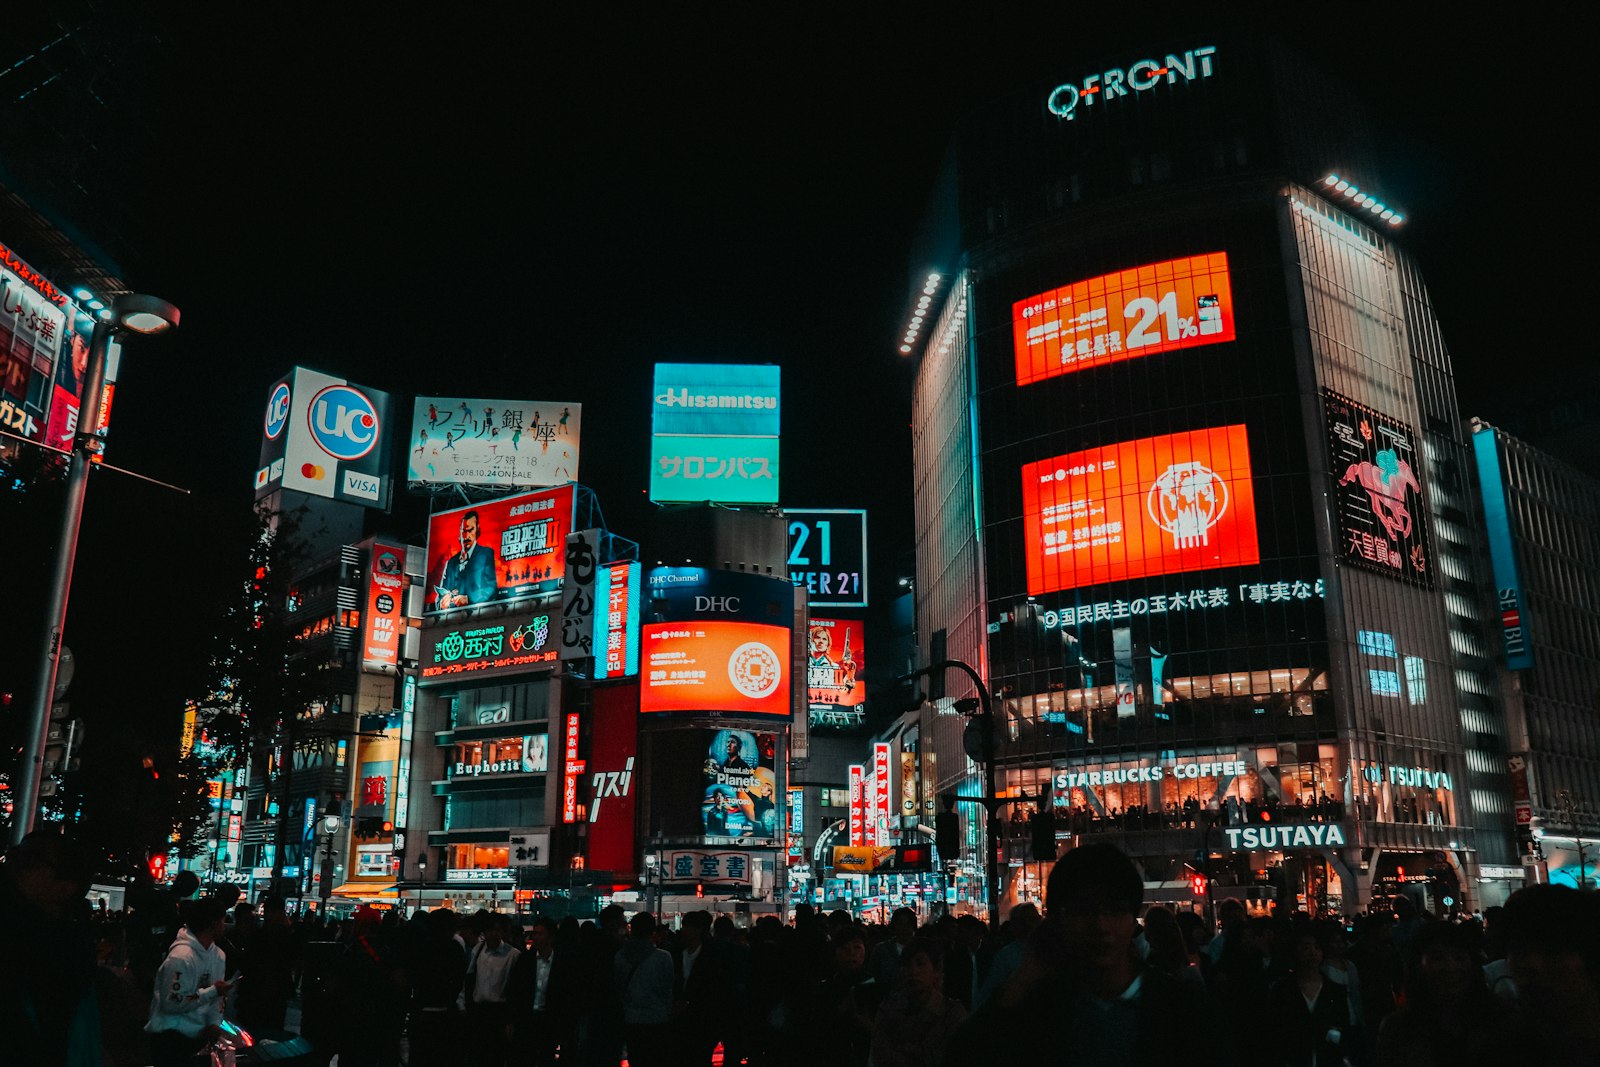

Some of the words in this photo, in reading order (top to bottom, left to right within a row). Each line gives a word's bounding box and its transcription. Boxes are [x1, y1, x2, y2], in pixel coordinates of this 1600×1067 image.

[1048, 46, 1216, 120] QFRONT
[655, 388, 777, 409] Hisamitsu
[454, 468, 497, 477] 2018.10.24
[497, 470, 511, 478] ON
[512, 471, 532, 479] SALE
[659, 456, 772, 479] サロンパス
[349, 477, 377, 494] VISA
[502, 527, 522, 546] RED
[522, 523, 547, 543] DEAD
[787, 520, 831, 566] 21
[501, 537, 547, 556] REDEMPTION
[650, 575, 667, 584] DHC
[667, 573, 699, 583] Channel
[836, 571, 858, 595] 21
[694, 595, 740, 613] DHC
[1498, 587, 1525, 655] SEIBU
[464, 634, 504, 659] 西村
[455, 758, 520, 777] Euphoria
[1056, 766, 1163, 789] STARBUCKS
[1174, 760, 1247, 780] COFFEE
[1388, 766, 1453, 791] TSUTAYA
[717, 772, 761, 787] Planets
[1225, 824, 1344, 849] TSUTAYA
